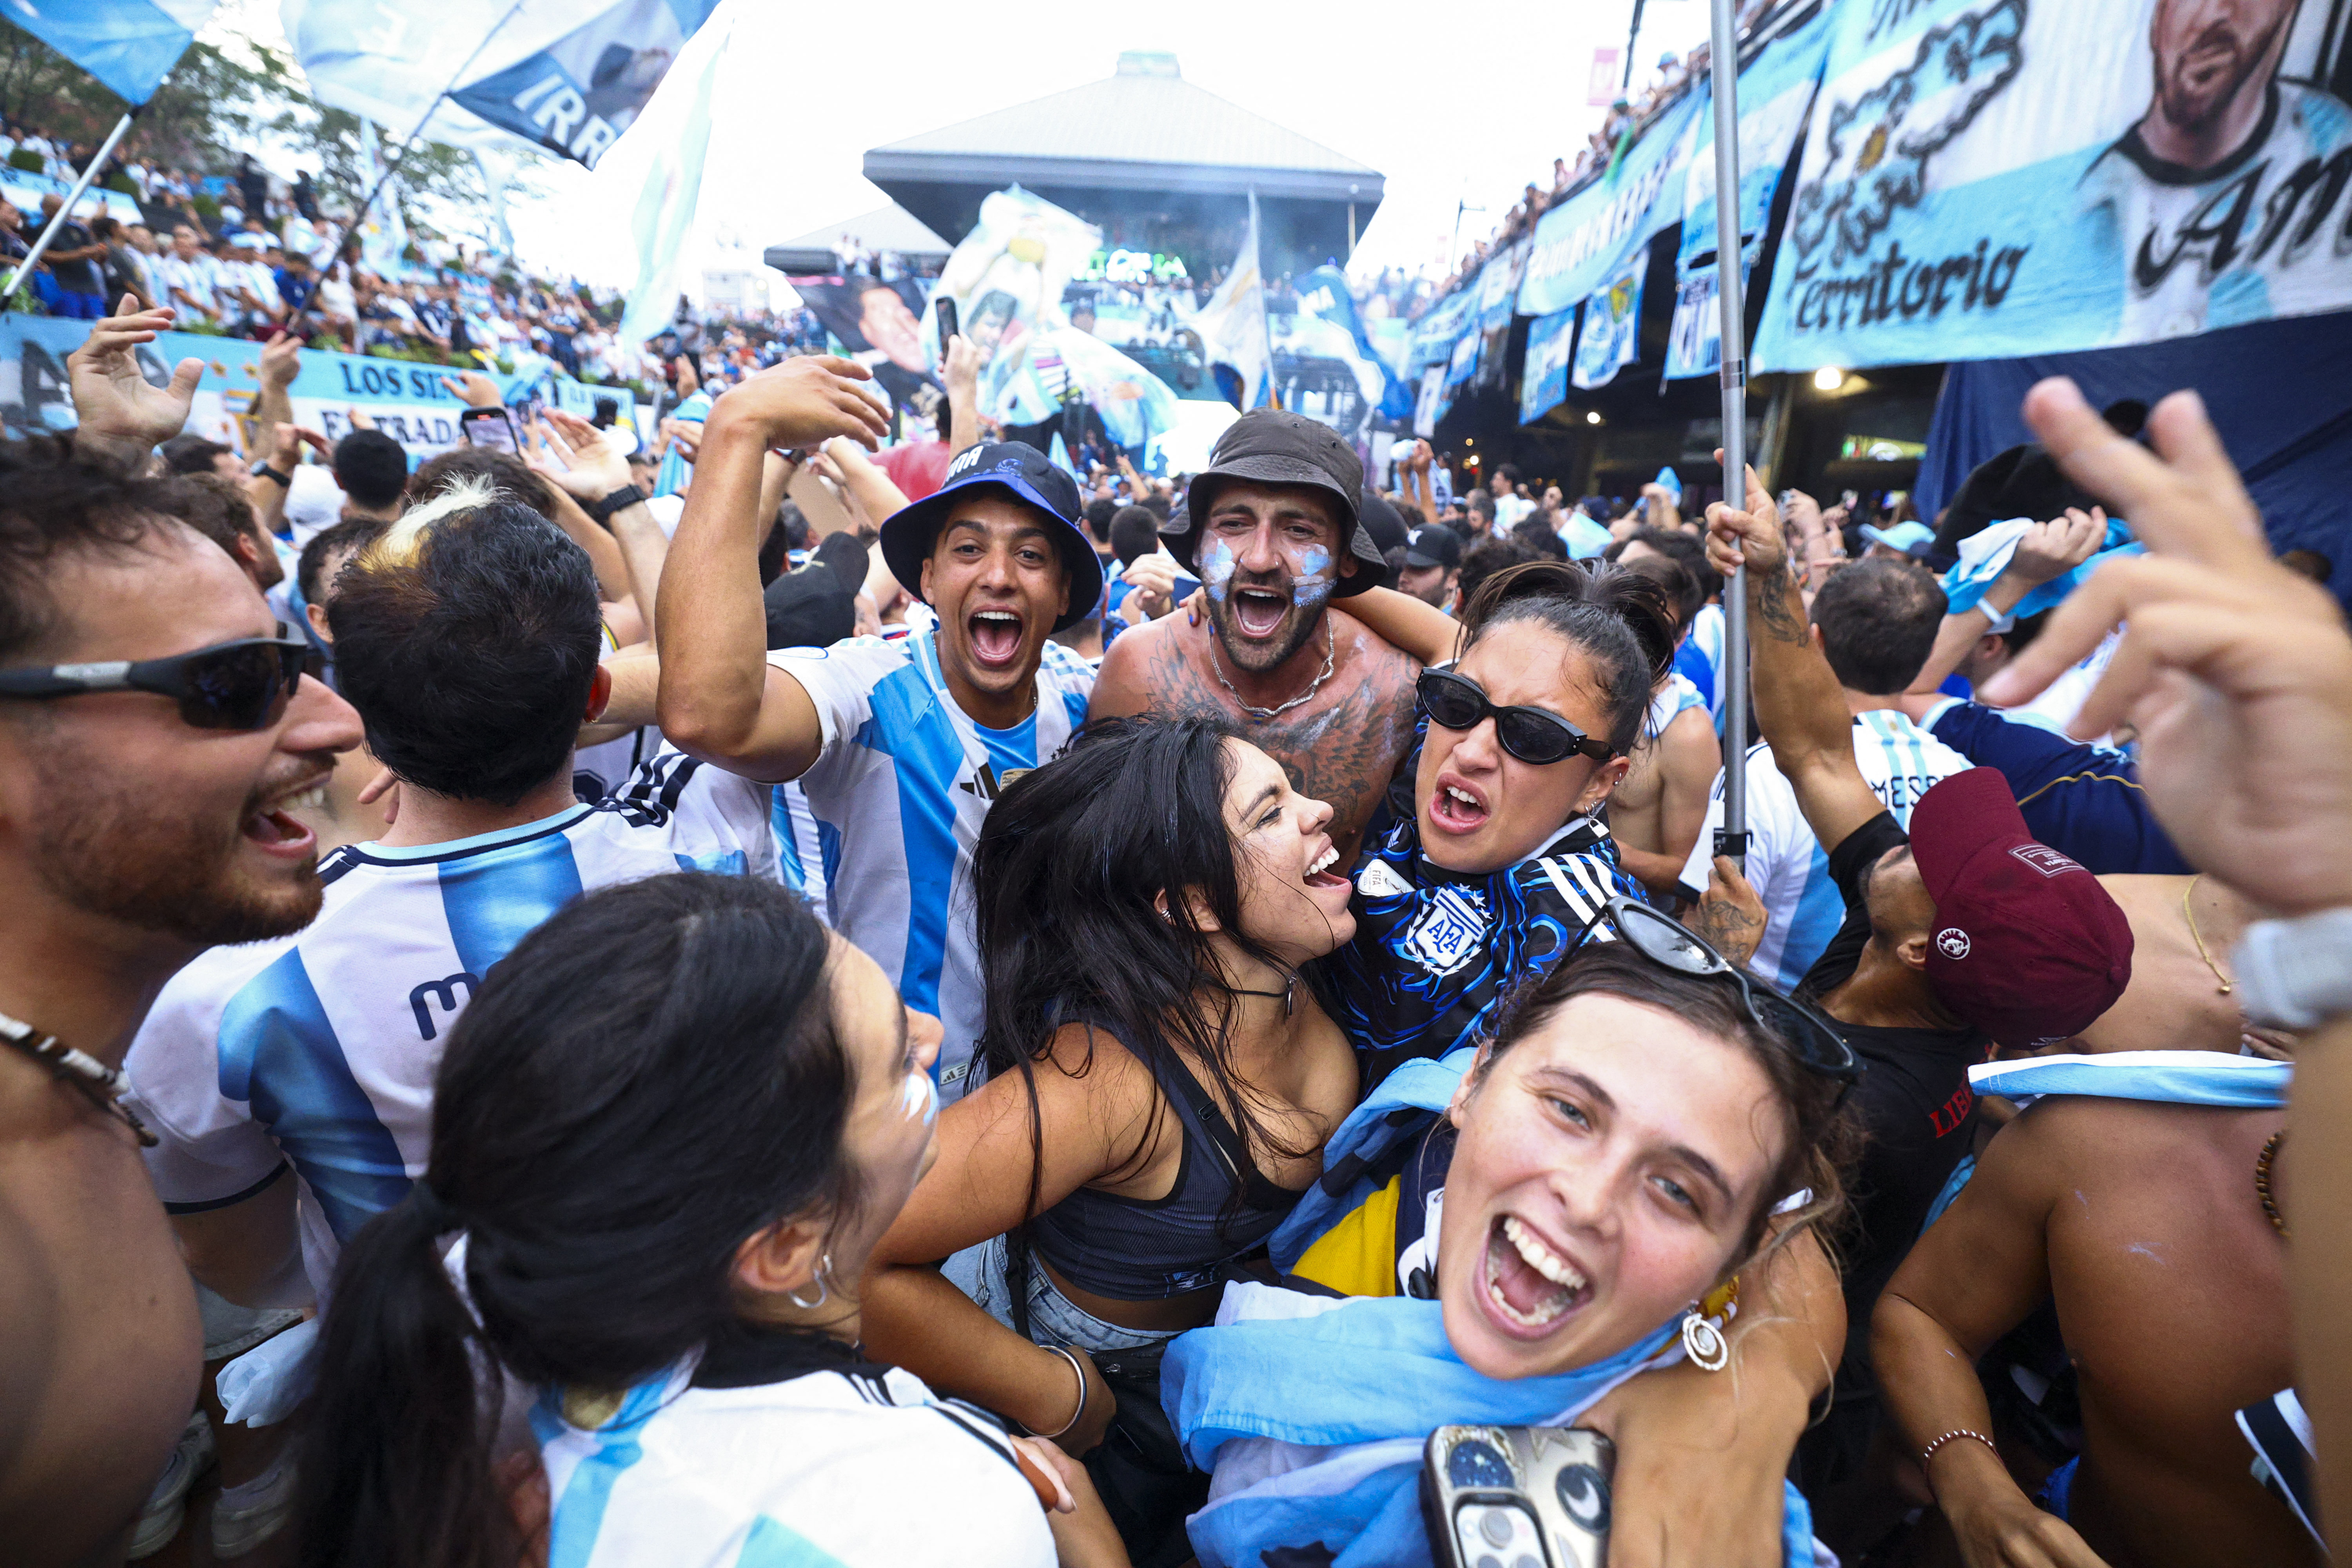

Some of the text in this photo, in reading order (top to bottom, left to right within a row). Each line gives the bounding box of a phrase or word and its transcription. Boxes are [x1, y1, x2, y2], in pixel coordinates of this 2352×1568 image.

[340, 362, 401, 394] LOS
[1372, 870, 1381, 886] FIFA
[1427, 911, 1465, 955] AFA
